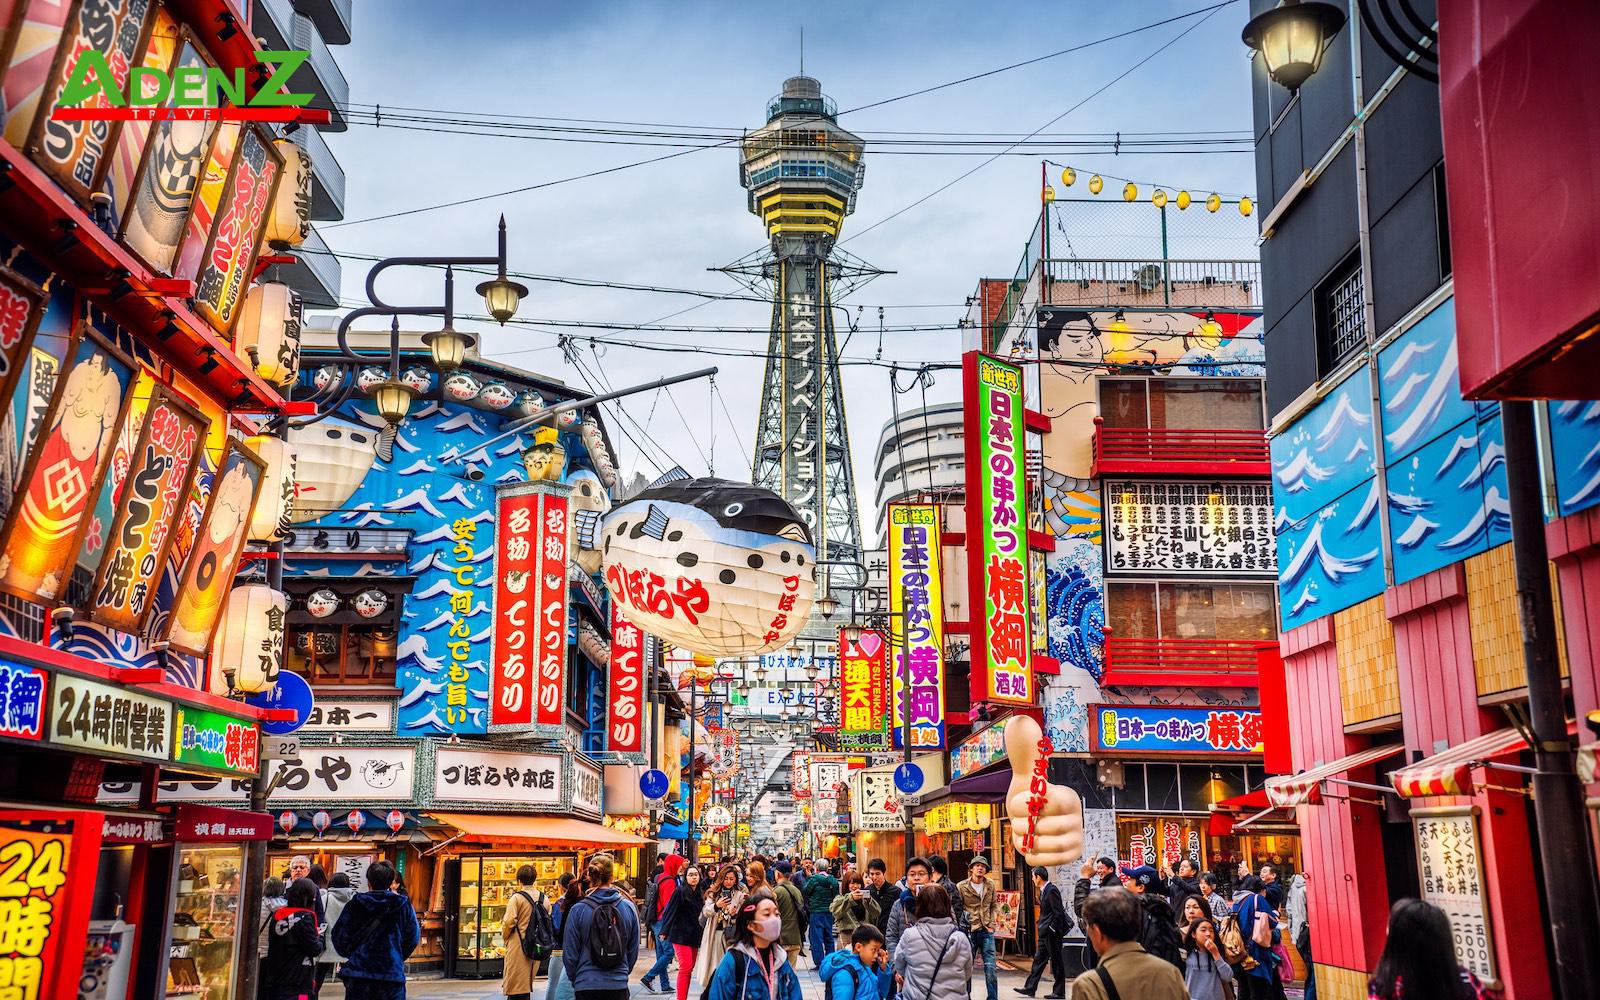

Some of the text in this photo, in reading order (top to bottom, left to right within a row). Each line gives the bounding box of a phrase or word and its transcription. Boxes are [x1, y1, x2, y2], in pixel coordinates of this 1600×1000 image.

[151, 406, 180, 451] 名物
[131, 424, 197, 616] 大阪下町の味
[893, 508, 935, 525] 新世界
[981, 362, 1028, 698] 新世界 日本一の串かつ 横綱 酒処
[1112, 526, 1125, 568] もち
[1127, 525, 1142, 568] うずら玉子
[1141, 525, 1156, 568] 紅しょうが
[1155, 526, 1169, 569] にんにく
[1170, 526, 1183, 569] 玉ねぎ
[1184, 526, 1199, 569] 山芋
[1200, 526, 1213, 569] しし唐
[1213, 526, 1228, 569] れんこん
[1227, 526, 1243, 569] 銀杏
[1243, 526, 1257, 569] 白ねぎ
[1257, 526, 1272, 570] さつま芋
[606, 562, 709, 625] づぼらや
[901, 526, 932, 643] 日本一の串かつ
[501, 507, 531, 713] 名物 てっちり
[540, 508, 565, 713] 名物 てっちり
[844, 659, 871, 730] 通天閣
[872, 660, 881, 730] TSUTENKAKU
[896, 646, 939, 725] 横綱
[57, 687, 166, 753] 24時間営業
[306, 707, 378, 725] 日本一
[1118, 718, 1205, 740] 日本一の串かつ
[225, 723, 258, 771] 横綱
[443, 764, 555, 790] づぼらや本店
